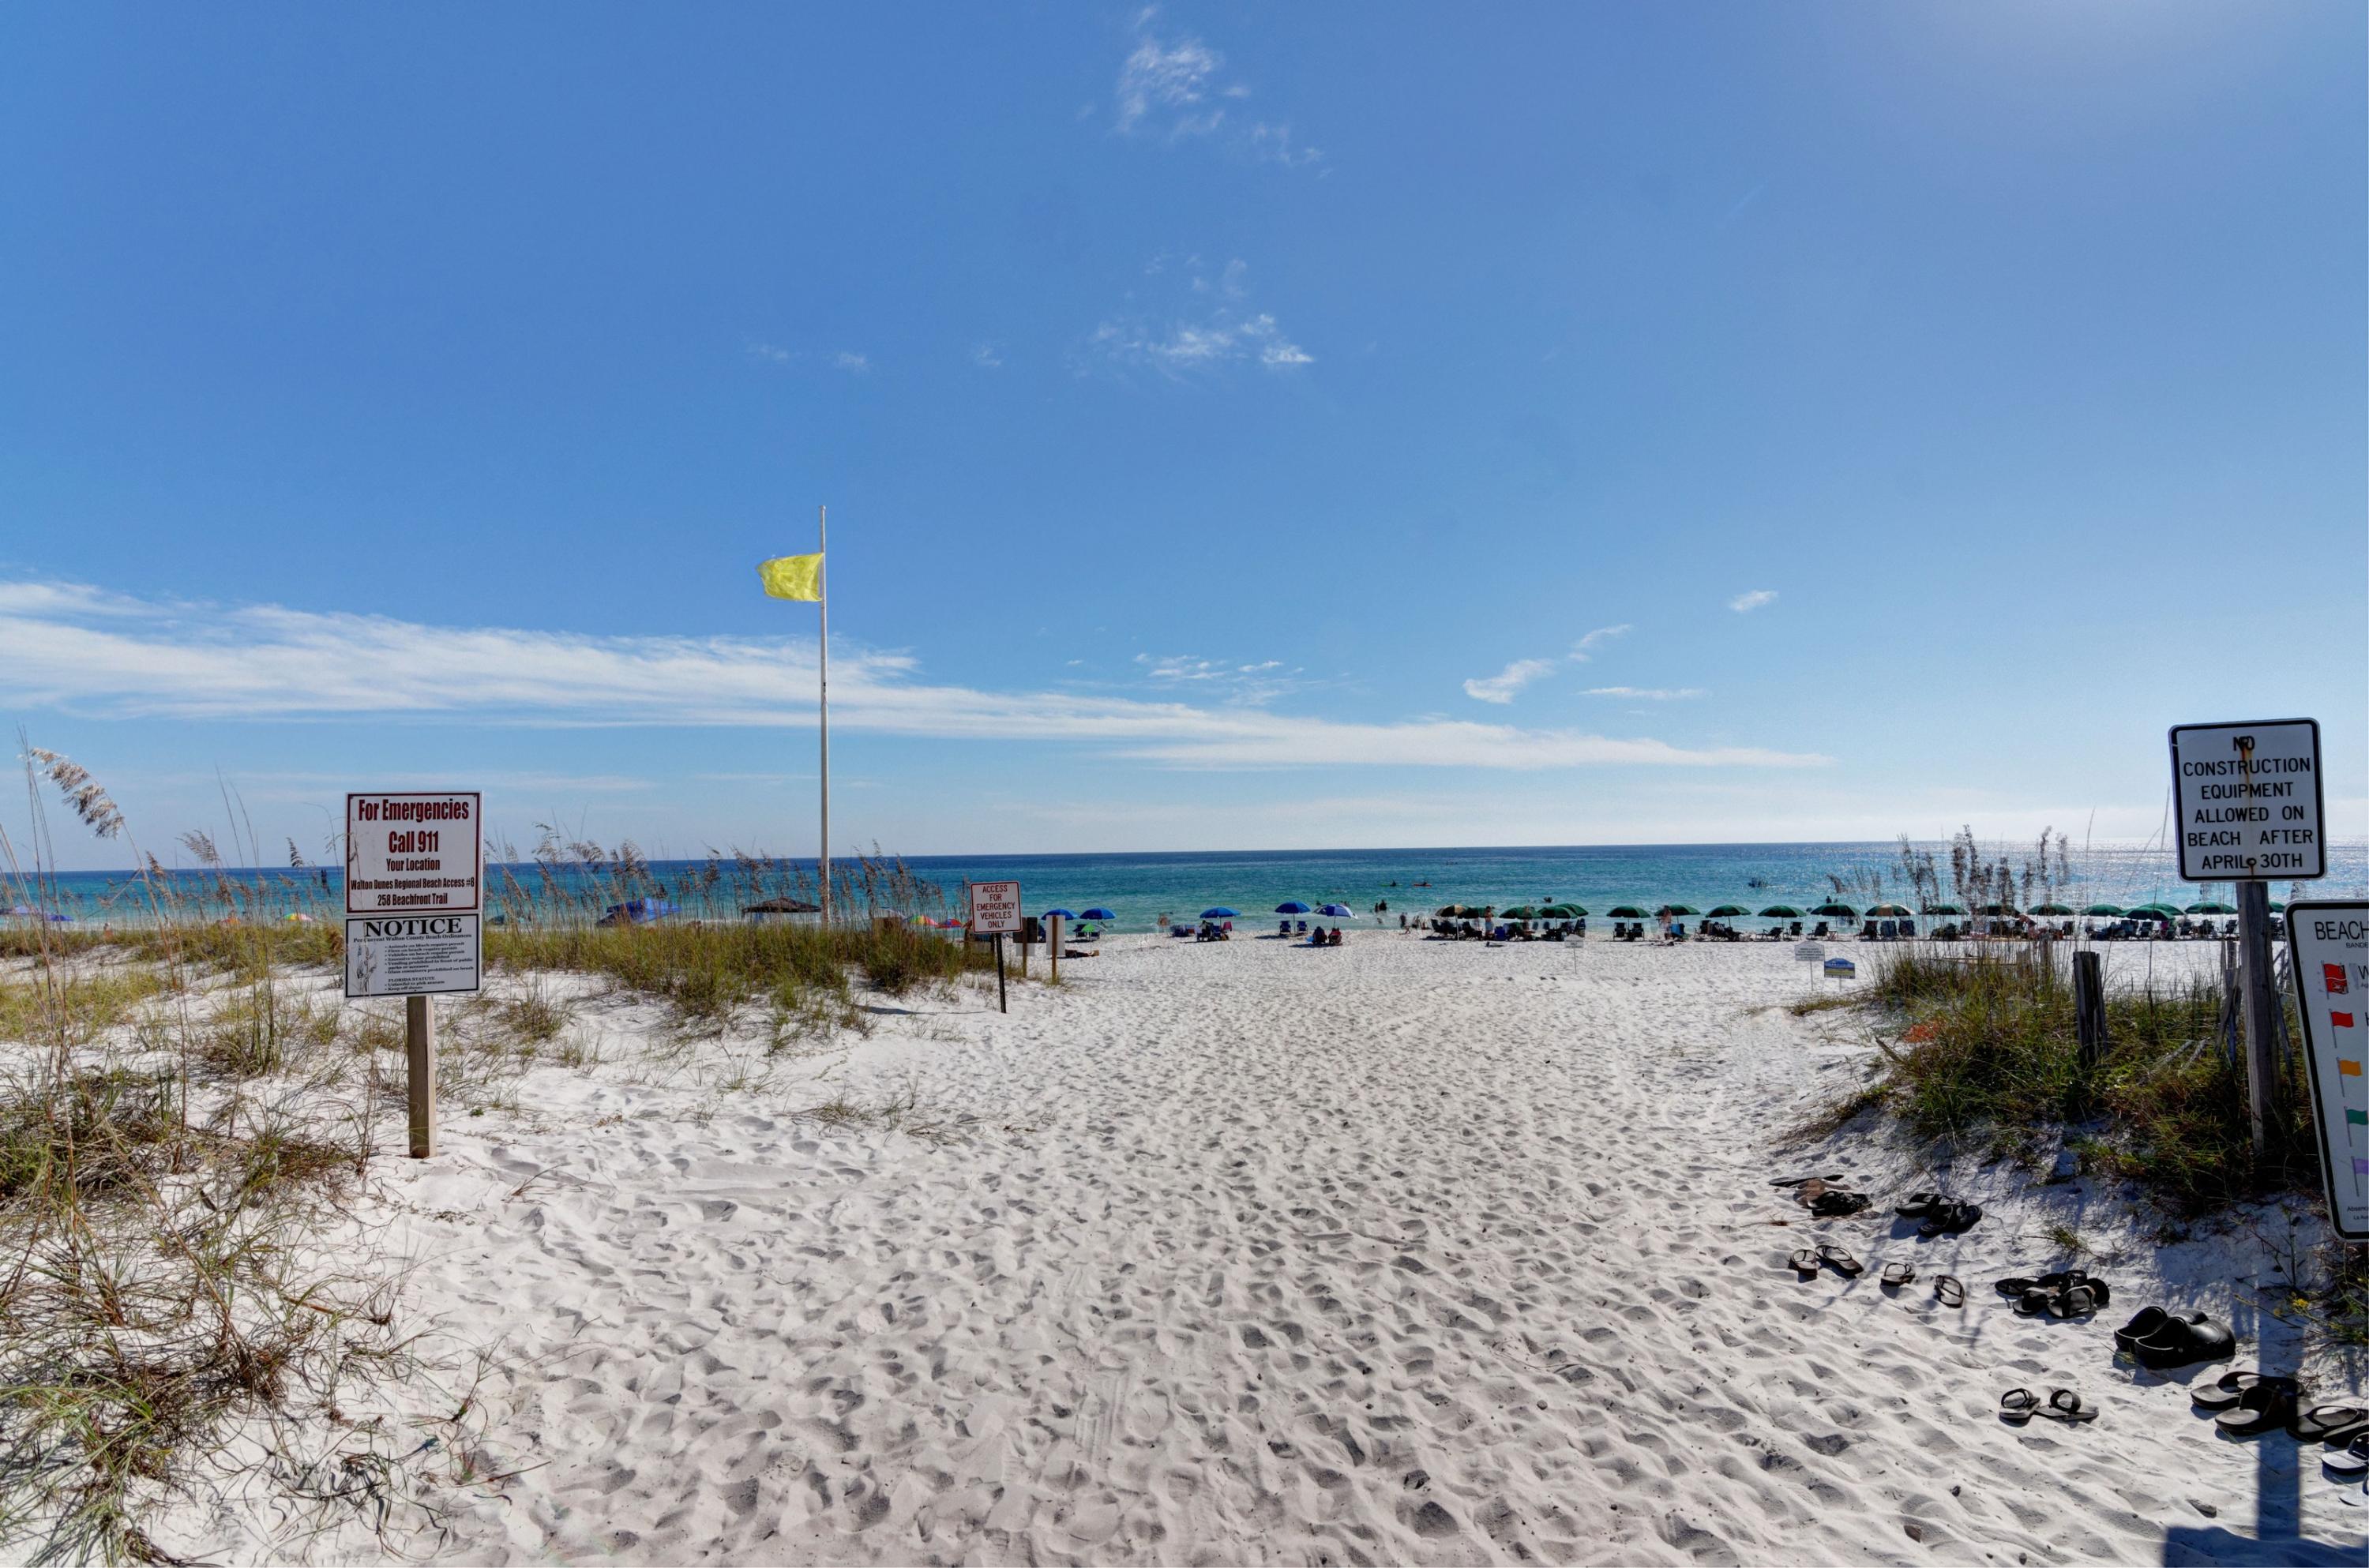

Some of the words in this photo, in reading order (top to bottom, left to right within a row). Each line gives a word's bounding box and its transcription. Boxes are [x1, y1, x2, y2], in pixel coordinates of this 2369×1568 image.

[2233, 736, 2255, 752] NO
[2183, 757, 2311, 777] CONSTRUCTION
[2201, 782, 2293, 800] EQUIPMENT
[359, 799, 379, 821] For
[382, 798, 469, 823] Emergencies
[2194, 807, 2269, 823] ALLOWED
[2282, 805, 2304, 820] ON
[389, 831, 415, 853] Call
[418, 831, 439, 852] 911
[2187, 831, 2241, 846] BEACH
[2259, 829, 2313, 845] AFTER
[386, 858, 404, 872] Your
[406, 857, 441, 871] Location
[2202, 855, 2247, 870] APRIL
[2260, 853, 2303, 868] 30TH
[351, 880, 373, 891] Walton
[374, 879, 393, 890] Dunes
[394, 878, 422, 890] Regional
[422, 878, 442, 888] Beach
[443, 877, 465, 887] Access
[377, 894, 391, 906] 258
[392, 893, 431, 906] Beachfront
[432, 892, 448, 905] Trail
[977, 902, 1016, 911] EMERGENCY
[980, 911, 1012, 920] VEHICLES
[366, 918, 462, 936] NOTICE
[2315, 921, 2368, 940] BEACH
